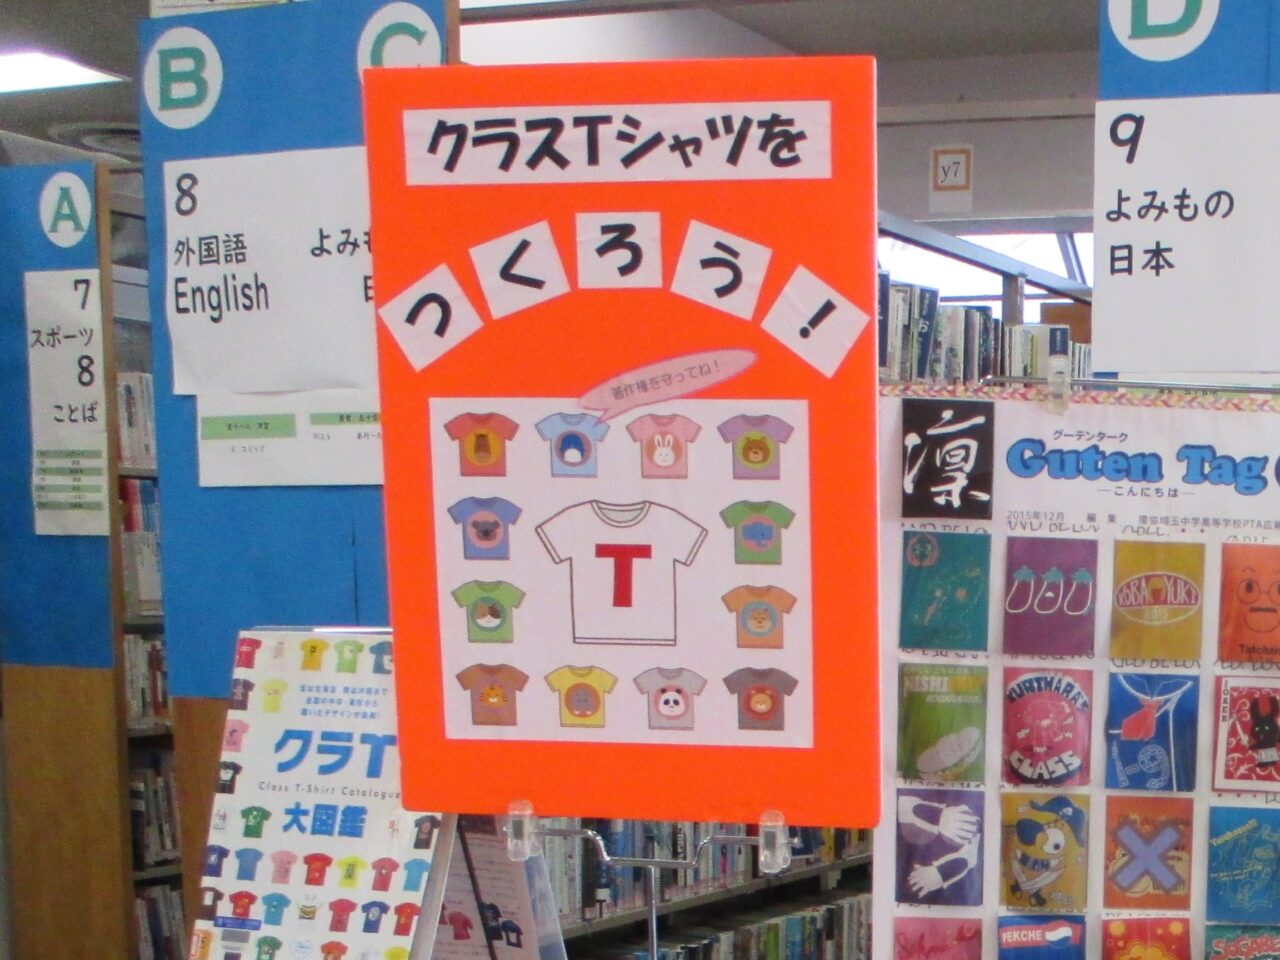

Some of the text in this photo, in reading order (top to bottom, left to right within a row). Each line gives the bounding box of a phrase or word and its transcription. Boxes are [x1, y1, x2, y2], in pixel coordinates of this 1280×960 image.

[157, 47, 208, 111] B
[427, 113, 807, 172] クラスTシャツを
[1109, 113, 1145, 164] 9
[940, 161, 960, 183] y7
[48, 186, 84, 234] A
[175, 173, 199, 216] 8
[1105, 188, 1235, 223] よみもの
[174, 233, 248, 266] 外国語
[1109, 240, 1176, 277] 日本
[74, 279, 91, 310] 7
[174, 273, 270, 323] English
[30, 325, 94, 347] スポーツ
[77, 355, 95, 387] 8
[54, 402, 99, 423] ことば
[1052, 430, 1129, 443] グーテンターク
[1006, 438, 1269, 496] Guten Tag
[1006, 511, 1065, 523] 2015年12月
[595, 543, 652, 607] T
[1008, 750, 1082, 781] CLASS
[258, 780, 290, 793] Class
[282, 802, 368, 838] 大図鑑
